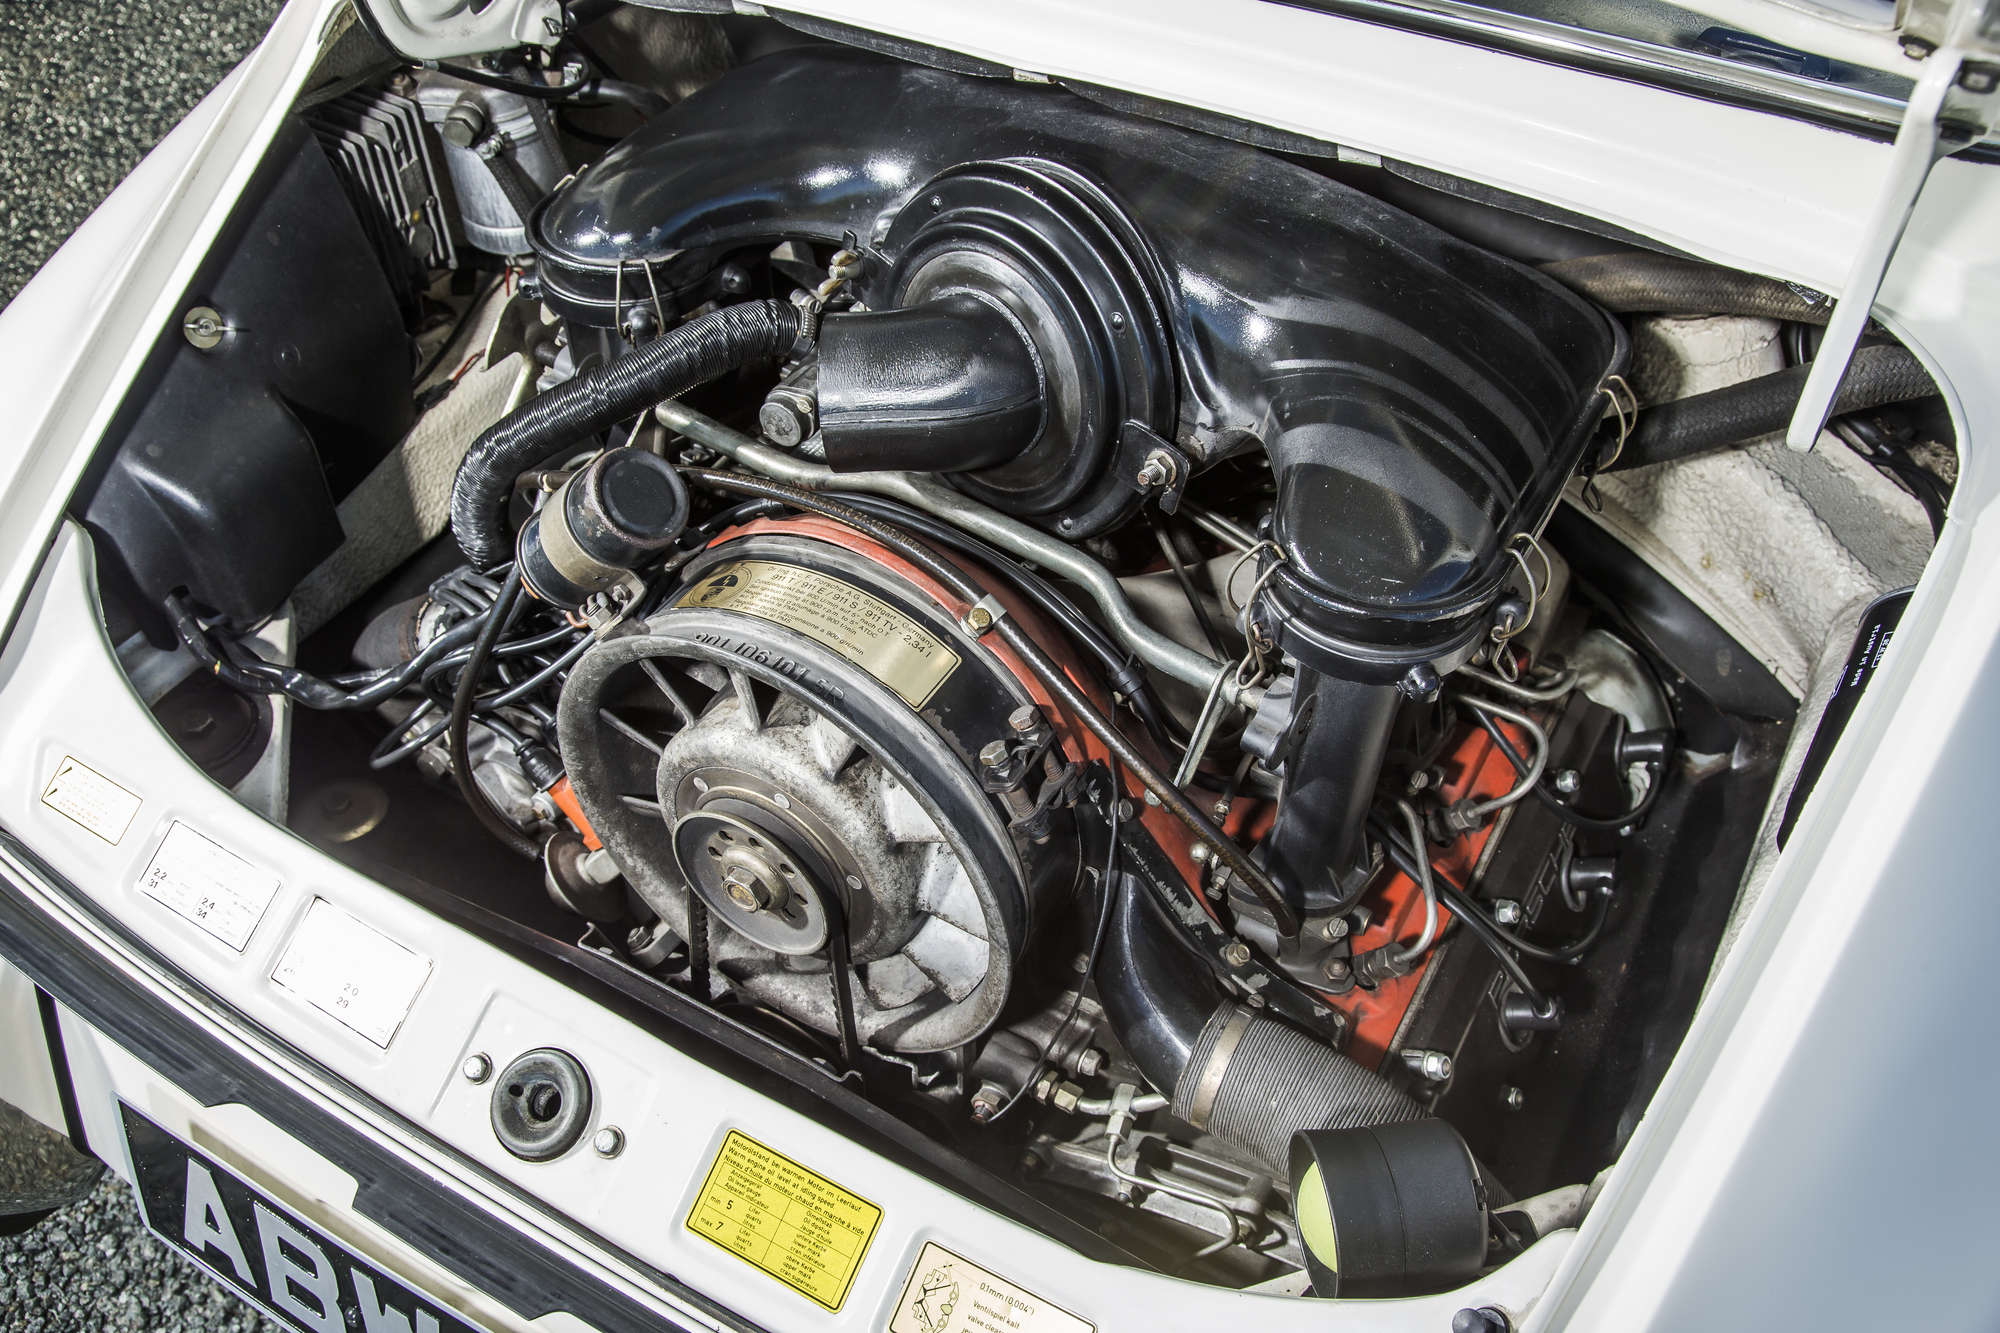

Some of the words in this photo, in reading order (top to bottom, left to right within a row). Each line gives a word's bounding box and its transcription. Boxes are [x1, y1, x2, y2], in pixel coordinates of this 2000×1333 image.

[772, 573, 785, 581] 911
[801, 581, 815, 591] 911
[816, 586, 826, 595] E
[832, 592, 848, 604] 911
[848, 599, 859, 610] S
[864, 609, 881, 622] 911
[883, 619, 897, 631] TV
[902, 634, 925, 653] 2,34
[814, 577, 843, 592] Porsche
[863, 598, 896, 621] Stuttgart
[901, 621, 935, 649] Germany
[860, 617, 876, 629] nach
[858, 624, 877, 638] ATDC
[728, 1147, 746, 1159] Warm
[746, 1158, 765, 1172] engine
[767, 1168, 775, 1176] oil
[777, 1173, 790, 1184] level
[791, 1181, 799, 1189] at
[799, 1186, 816, 1199] idling
[724, 1155, 743, 1169] Niveau
[763, 1176, 772, 1185] du
[773, 1182, 793, 1196] moteur
[795, 1193, 813, 1207] chaud
[814, 1204, 822, 1212] en
[823, 1209, 845, 1225] marche
[852, 1225, 864, 1235] vide
[771, 1160, 781, 1168] bei
[807, 1179, 824, 1192] Motor
[836, 1195, 861, 1212] Leerlauf
[710, 1195, 721, 1204] min
[725, 1199, 734, 1210] 5
[700, 1217, 712, 1226] max
[714, 1220, 723, 1232] 7
[745, 1213, 761, 1224] quarts
[736, 1234, 752, 1246] quarts
[973, 1300, 1006, 1322] Ventilspiel
[1006, 1316, 1020, 1329] kalt
